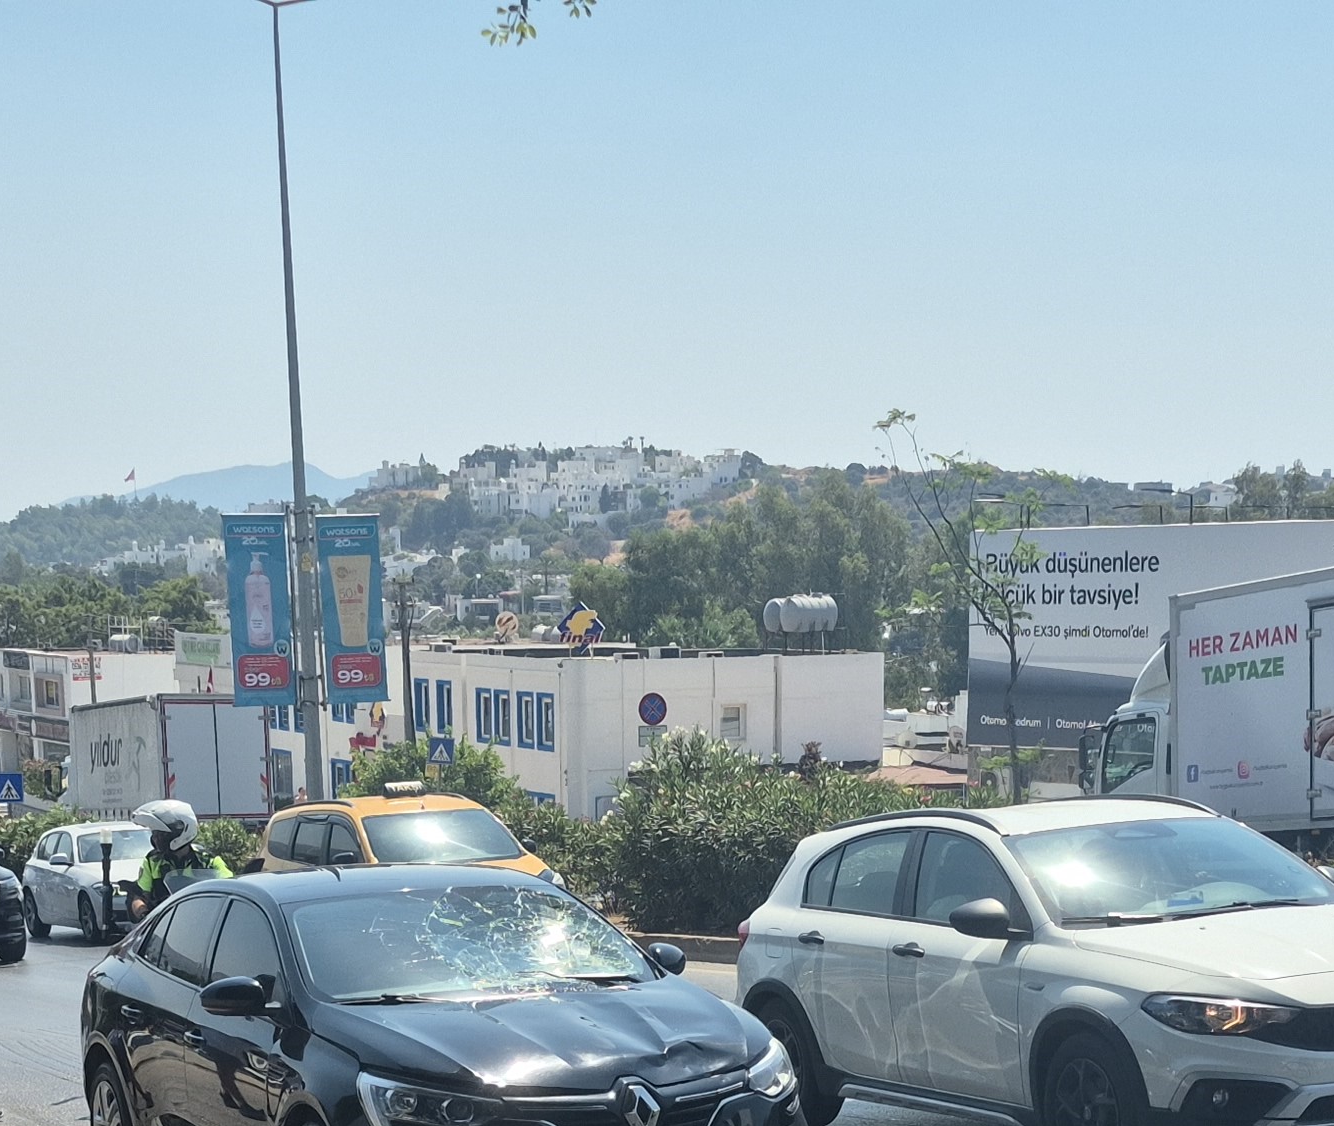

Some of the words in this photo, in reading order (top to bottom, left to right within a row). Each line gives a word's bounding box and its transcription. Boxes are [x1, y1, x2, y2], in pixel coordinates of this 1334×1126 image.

[232, 525, 276, 535] watsons
[326, 527, 368, 536] watsons
[1045, 550, 1160, 578] düşünenlere
[1041, 583, 1065, 605] bir
[1069, 582, 1140, 610] tavsiye!
[559, 631, 602, 644] final
[1034, 625, 1061, 637] EX30
[1064, 625, 1090, 639] şimdi
[1189, 635, 1223, 658] HER
[1229, 623, 1298, 652] ZAMAN
[1201, 656, 1284, 686] TAPTAZE
